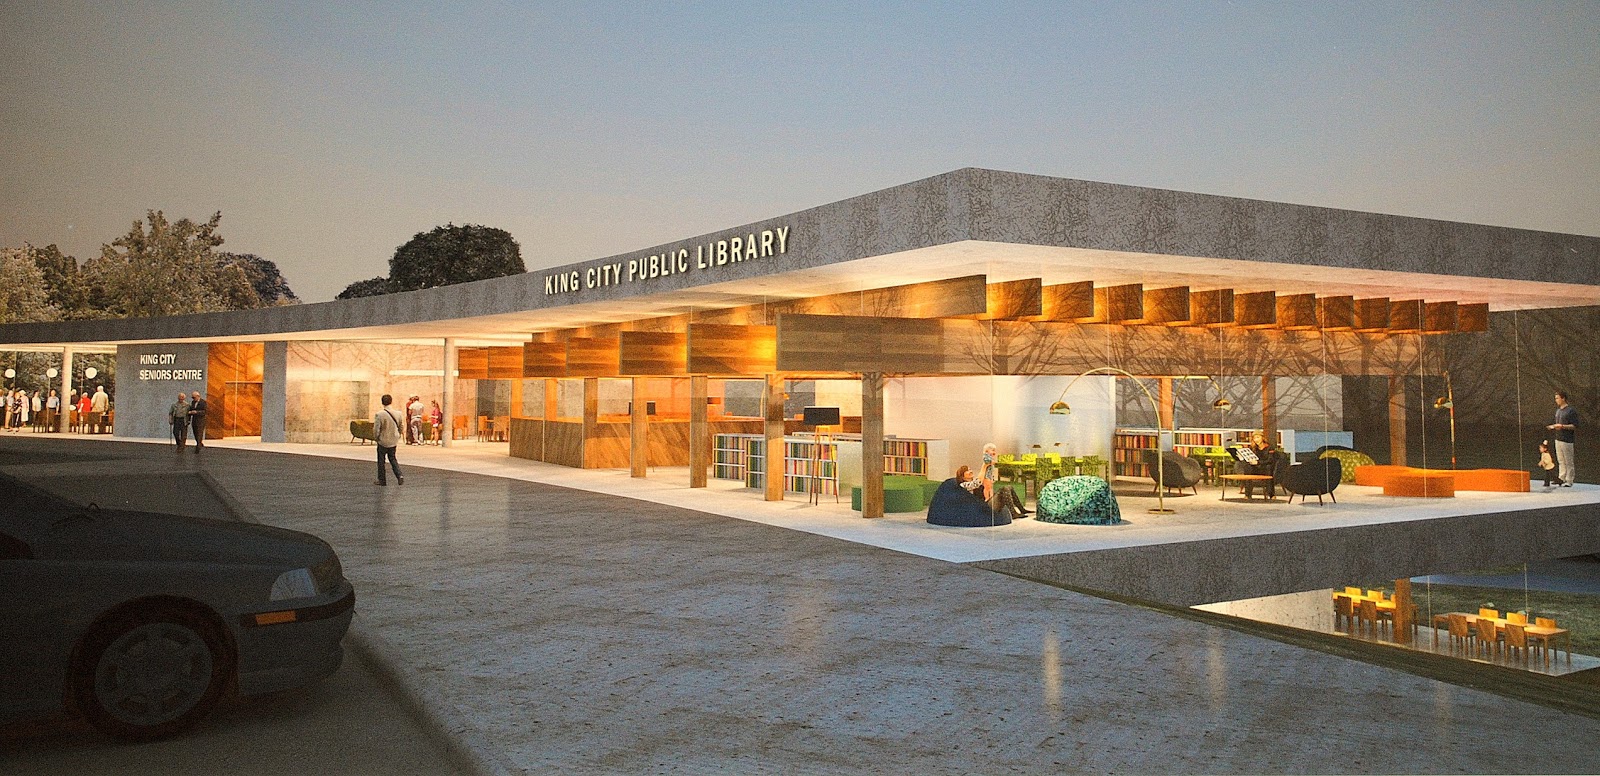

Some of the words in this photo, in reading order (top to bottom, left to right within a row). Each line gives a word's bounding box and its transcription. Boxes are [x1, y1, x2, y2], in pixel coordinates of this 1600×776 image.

[545, 270, 579, 295] KING
[586, 262, 622, 289] CITY
[628, 248, 688, 282] PUBLIC
[697, 225, 790, 269] LIBRARY
[140, 354, 158, 365] KING
[159, 354, 176, 364] CITY
[139, 369, 172, 380] SENIORS
[173, 369, 203, 380] CENTRE
